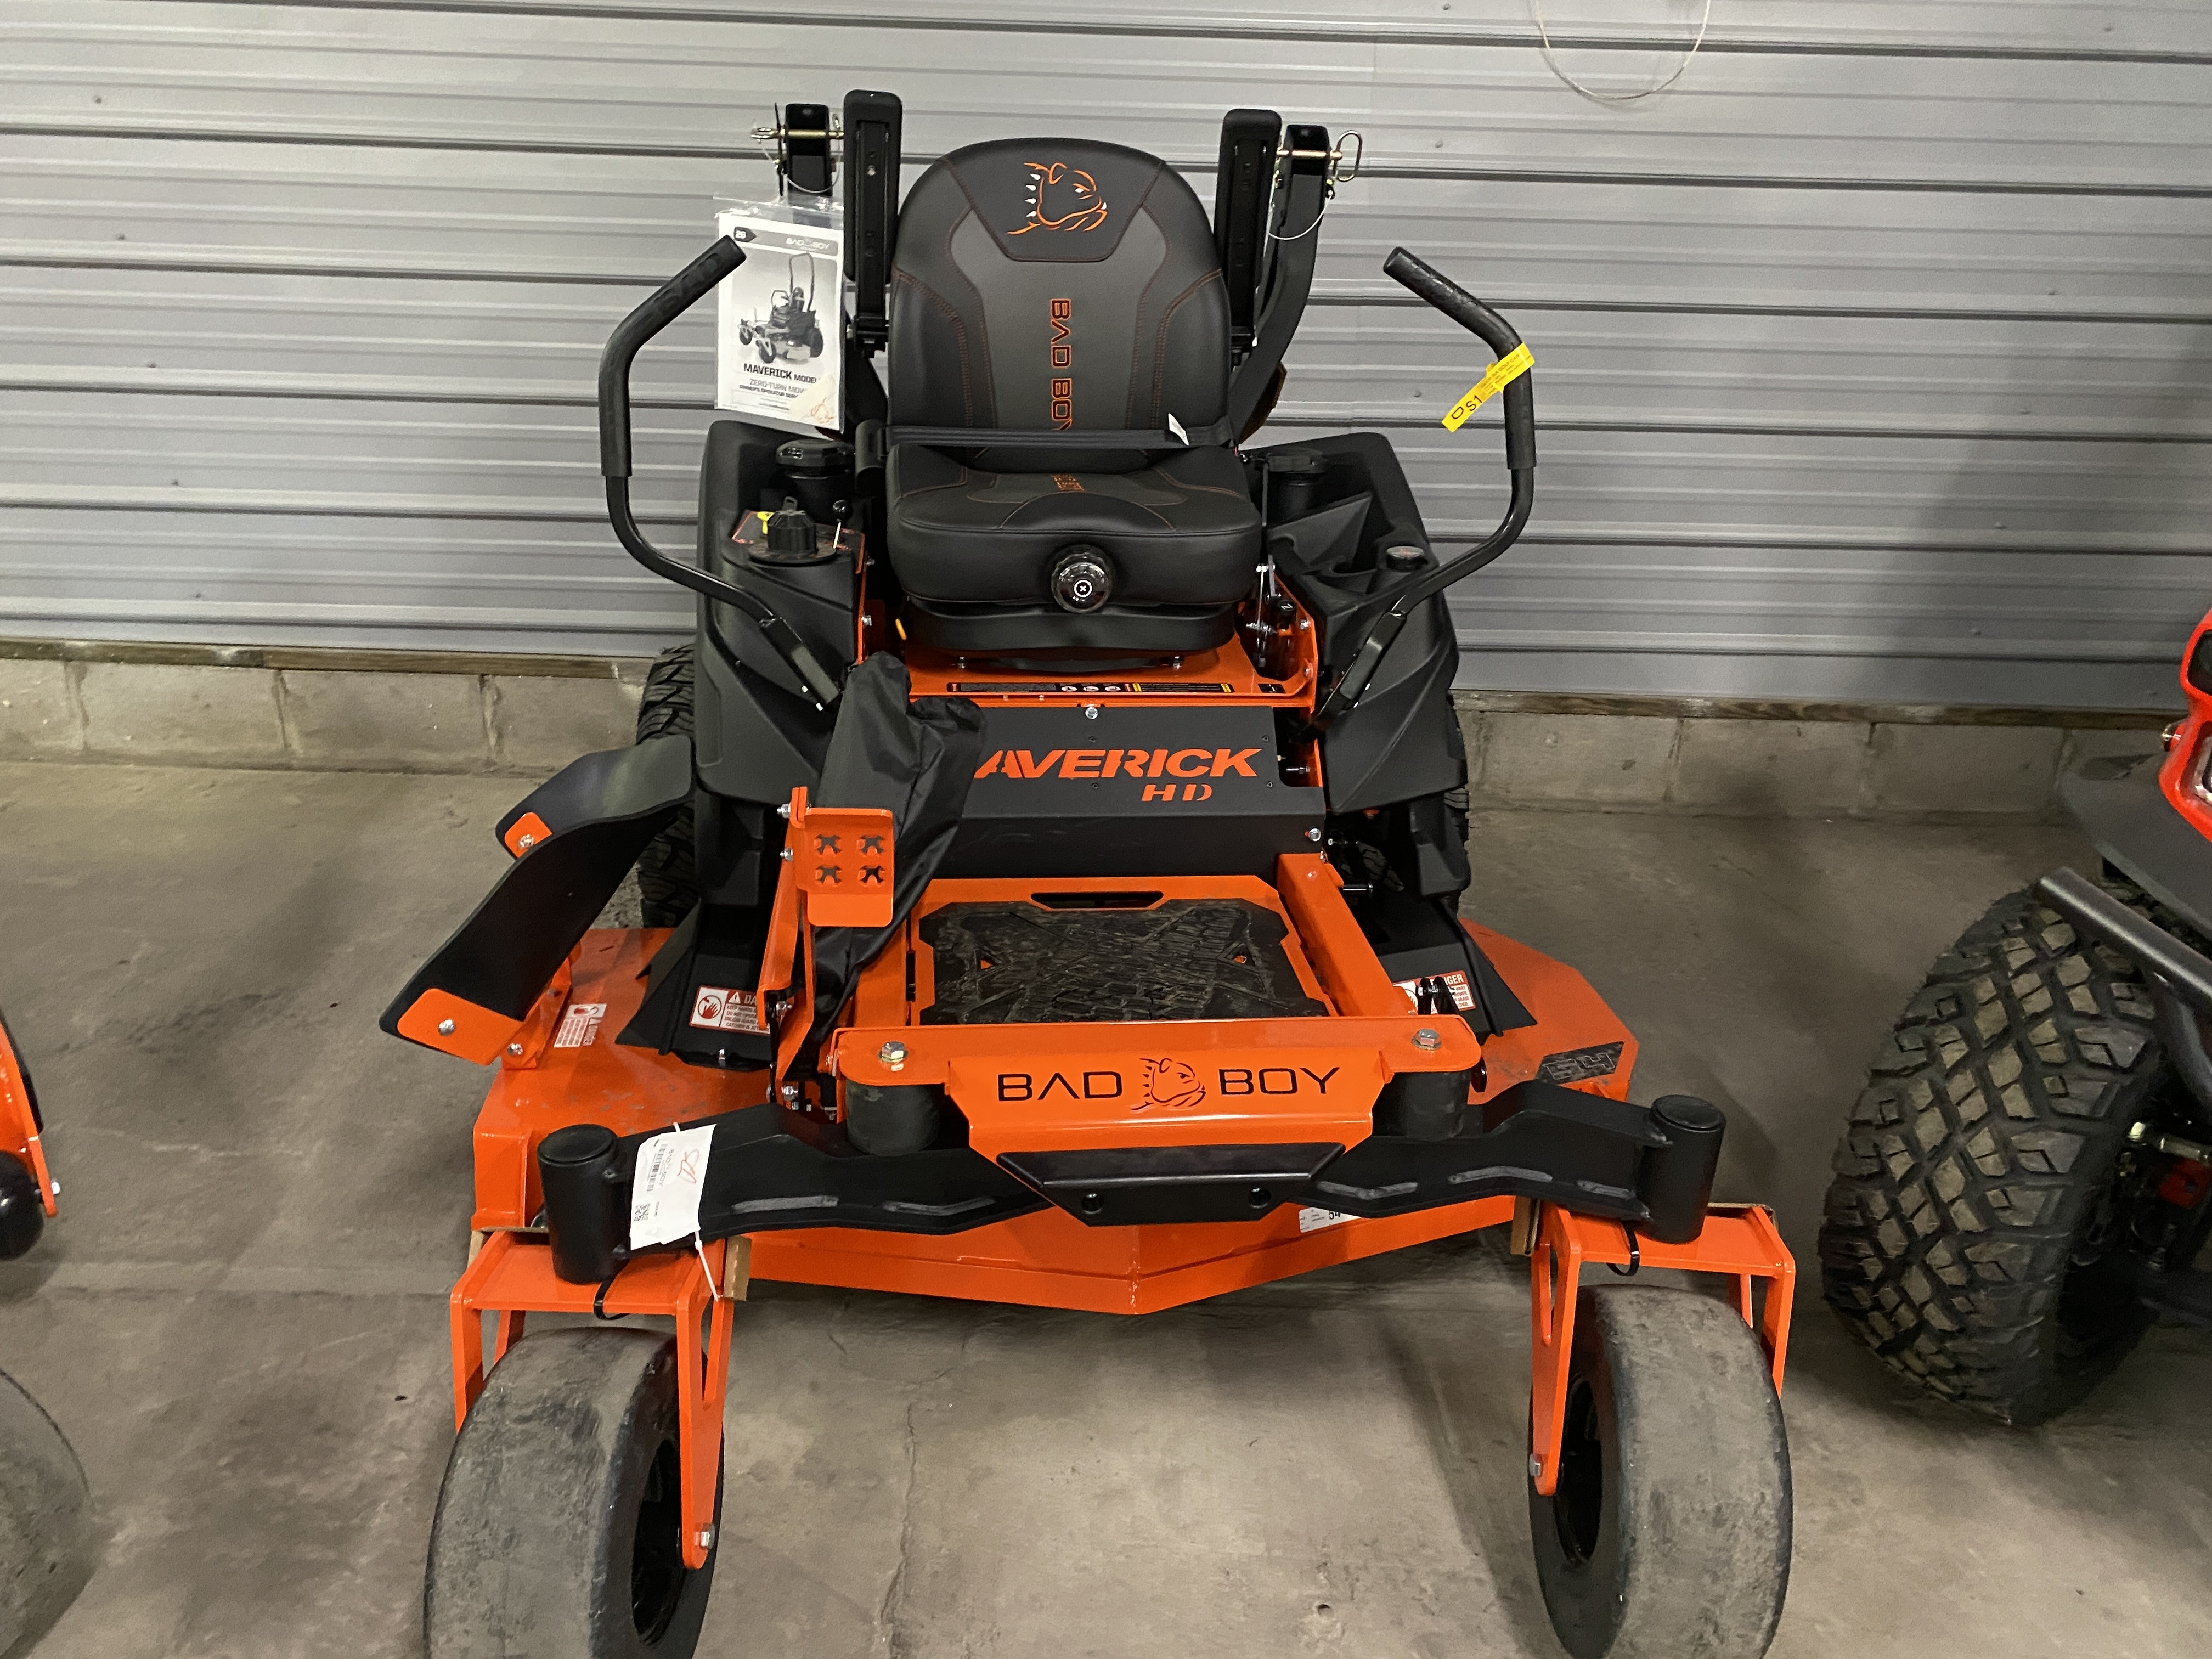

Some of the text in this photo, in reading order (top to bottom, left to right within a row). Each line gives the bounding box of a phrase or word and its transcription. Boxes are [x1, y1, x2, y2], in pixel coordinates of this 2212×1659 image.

[1050, 298, 1071, 369] BAD
[743, 363, 793, 380] MAVERICK
[974, 748, 1261, 778] AVERICK
[1141, 783, 1212, 802] HD
[997, 1066, 1341, 1102] BAD BOY
